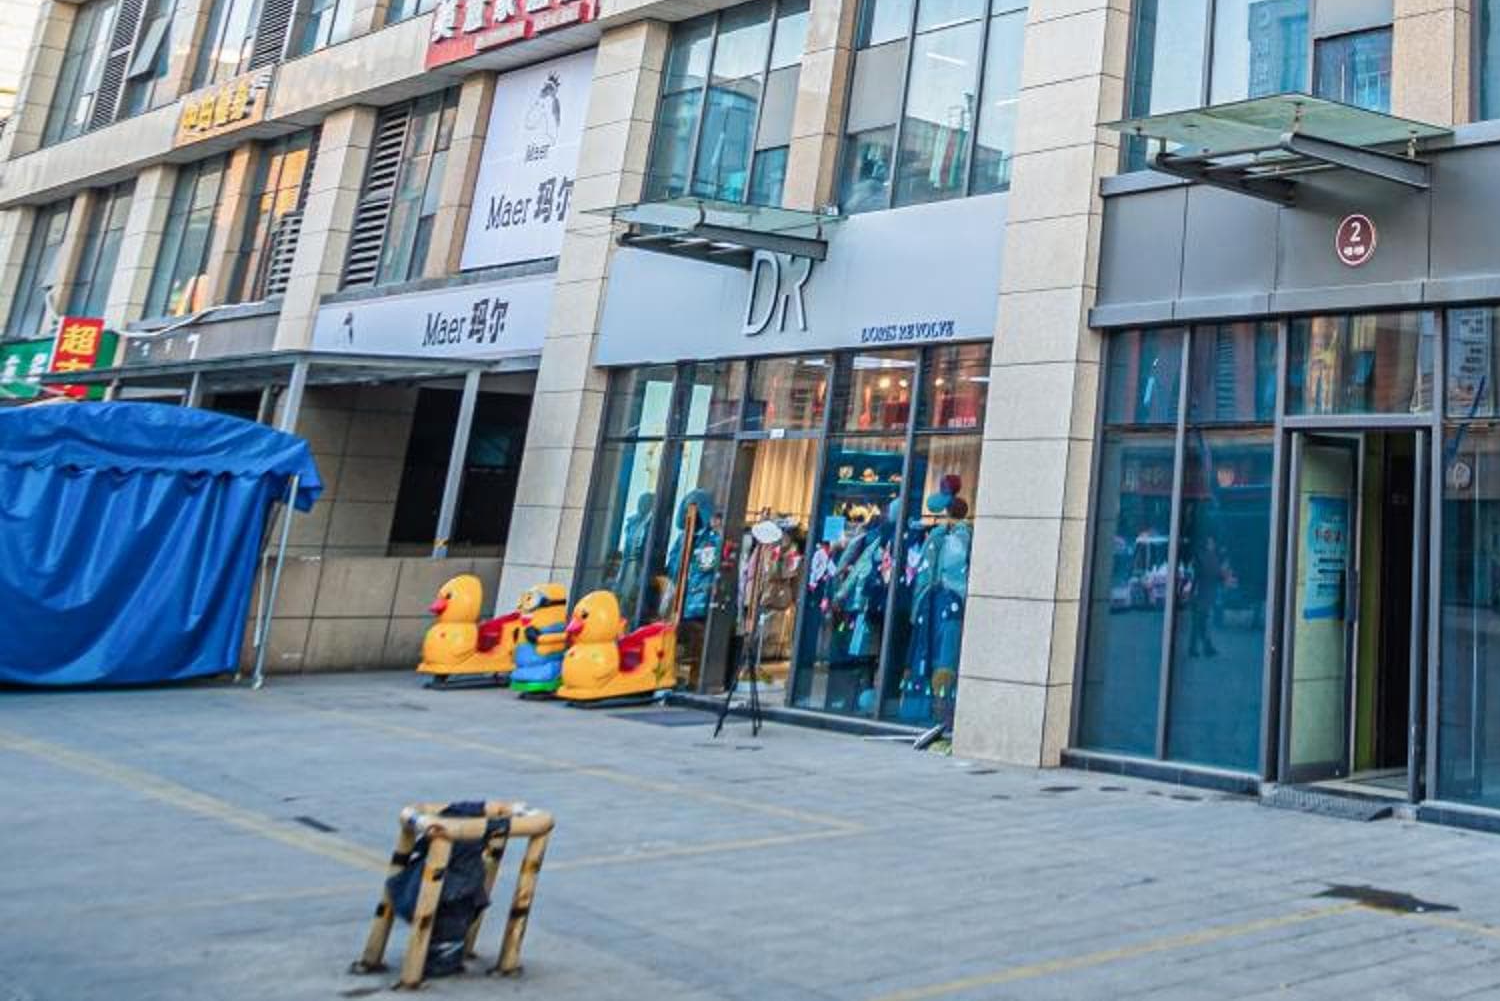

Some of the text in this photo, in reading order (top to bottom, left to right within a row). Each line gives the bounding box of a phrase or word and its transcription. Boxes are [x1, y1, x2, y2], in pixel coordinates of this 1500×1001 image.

[486, 195, 532, 231] Maer
[1350, 221, 1361, 242] 2
[742, 248, 813, 337] DR
[421, 297, 509, 347] Maer 玛尔
